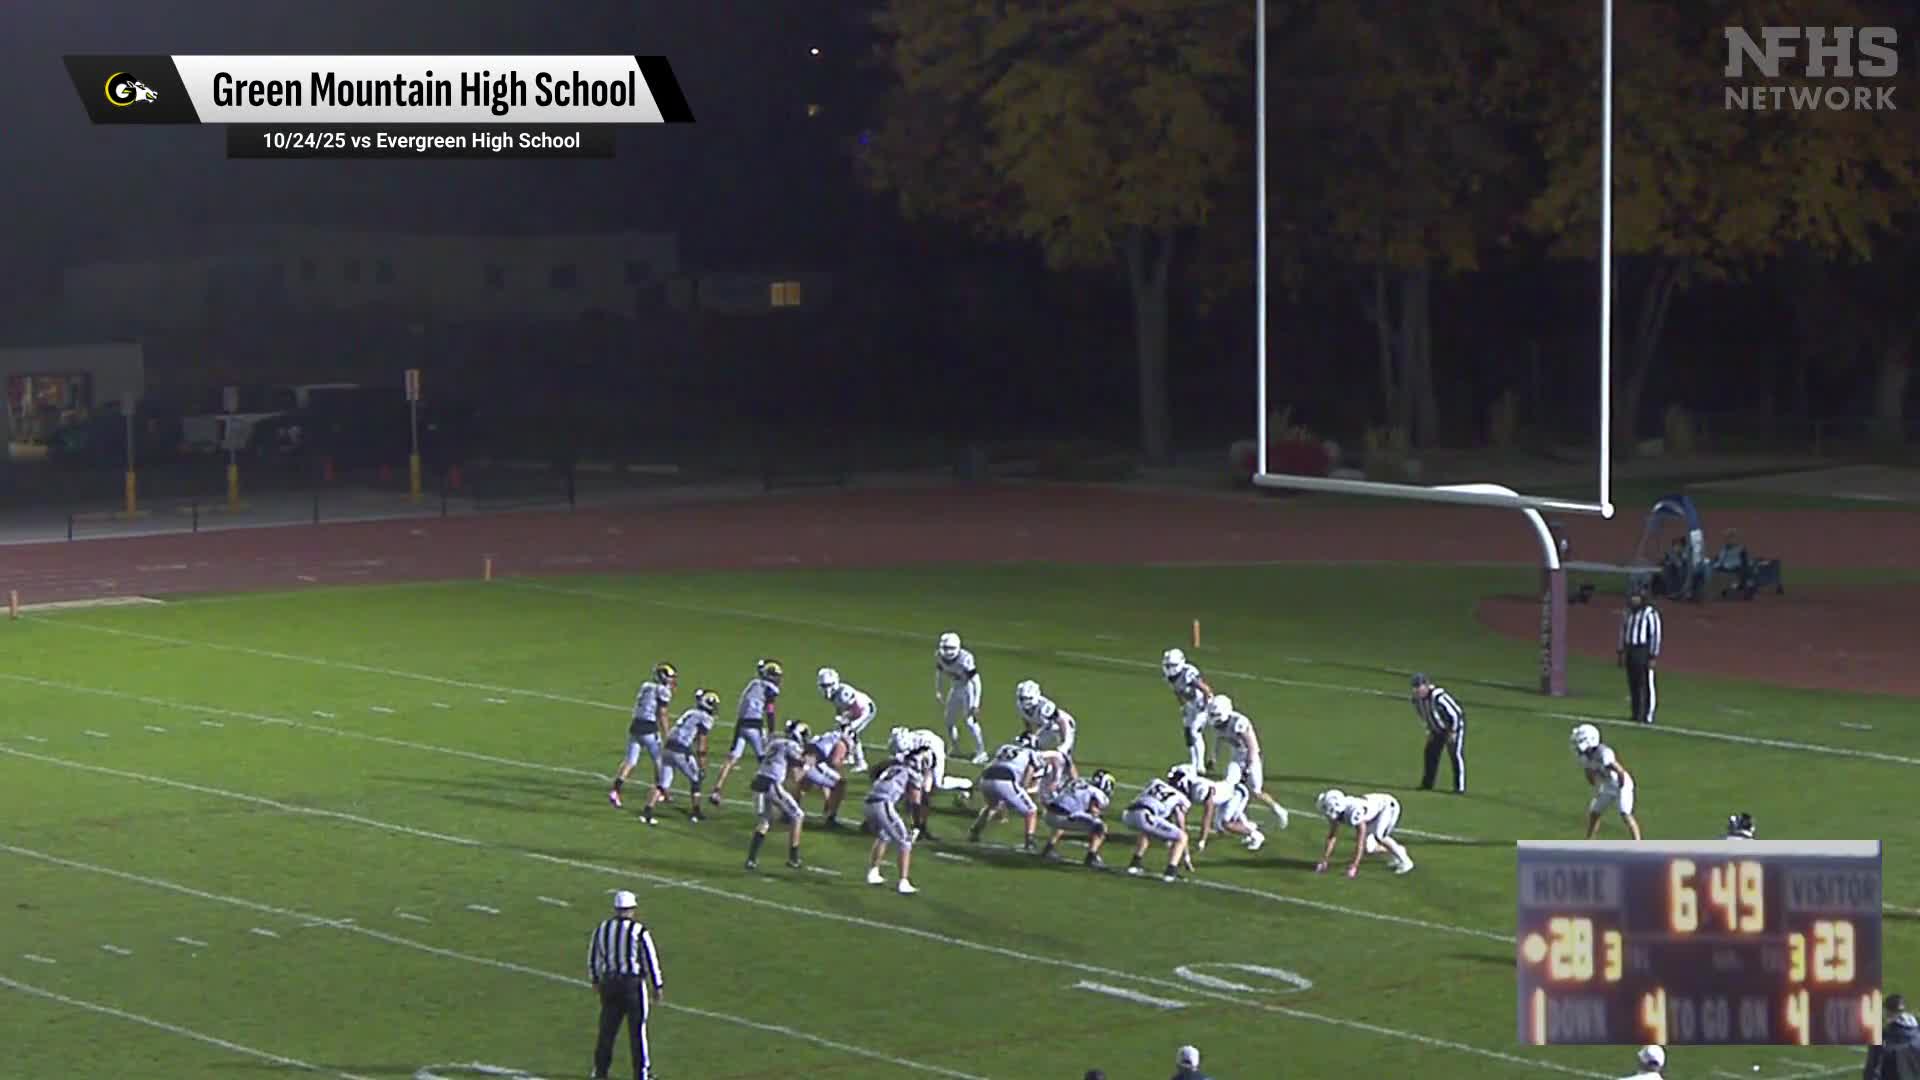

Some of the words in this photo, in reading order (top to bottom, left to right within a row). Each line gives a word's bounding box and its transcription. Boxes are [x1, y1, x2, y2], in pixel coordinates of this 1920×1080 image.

[1533, 868, 1606, 901] HOME
[1670, 858, 1698, 932] 6
[1711, 860, 1764, 932] 49
[1790, 870, 1877, 906] VISITOR
[1548, 916, 1594, 981] 28
[1603, 930, 1622, 981] 3
[1787, 932, 1806, 982] 3
[1812, 919, 1856, 982] 23
[1549, 997, 1608, 1039] DOWN
[1642, 988, 1667, 1045] 4
[1786, 989, 1810, 1045] 4
[1861, 988, 1882, 1045] 4
